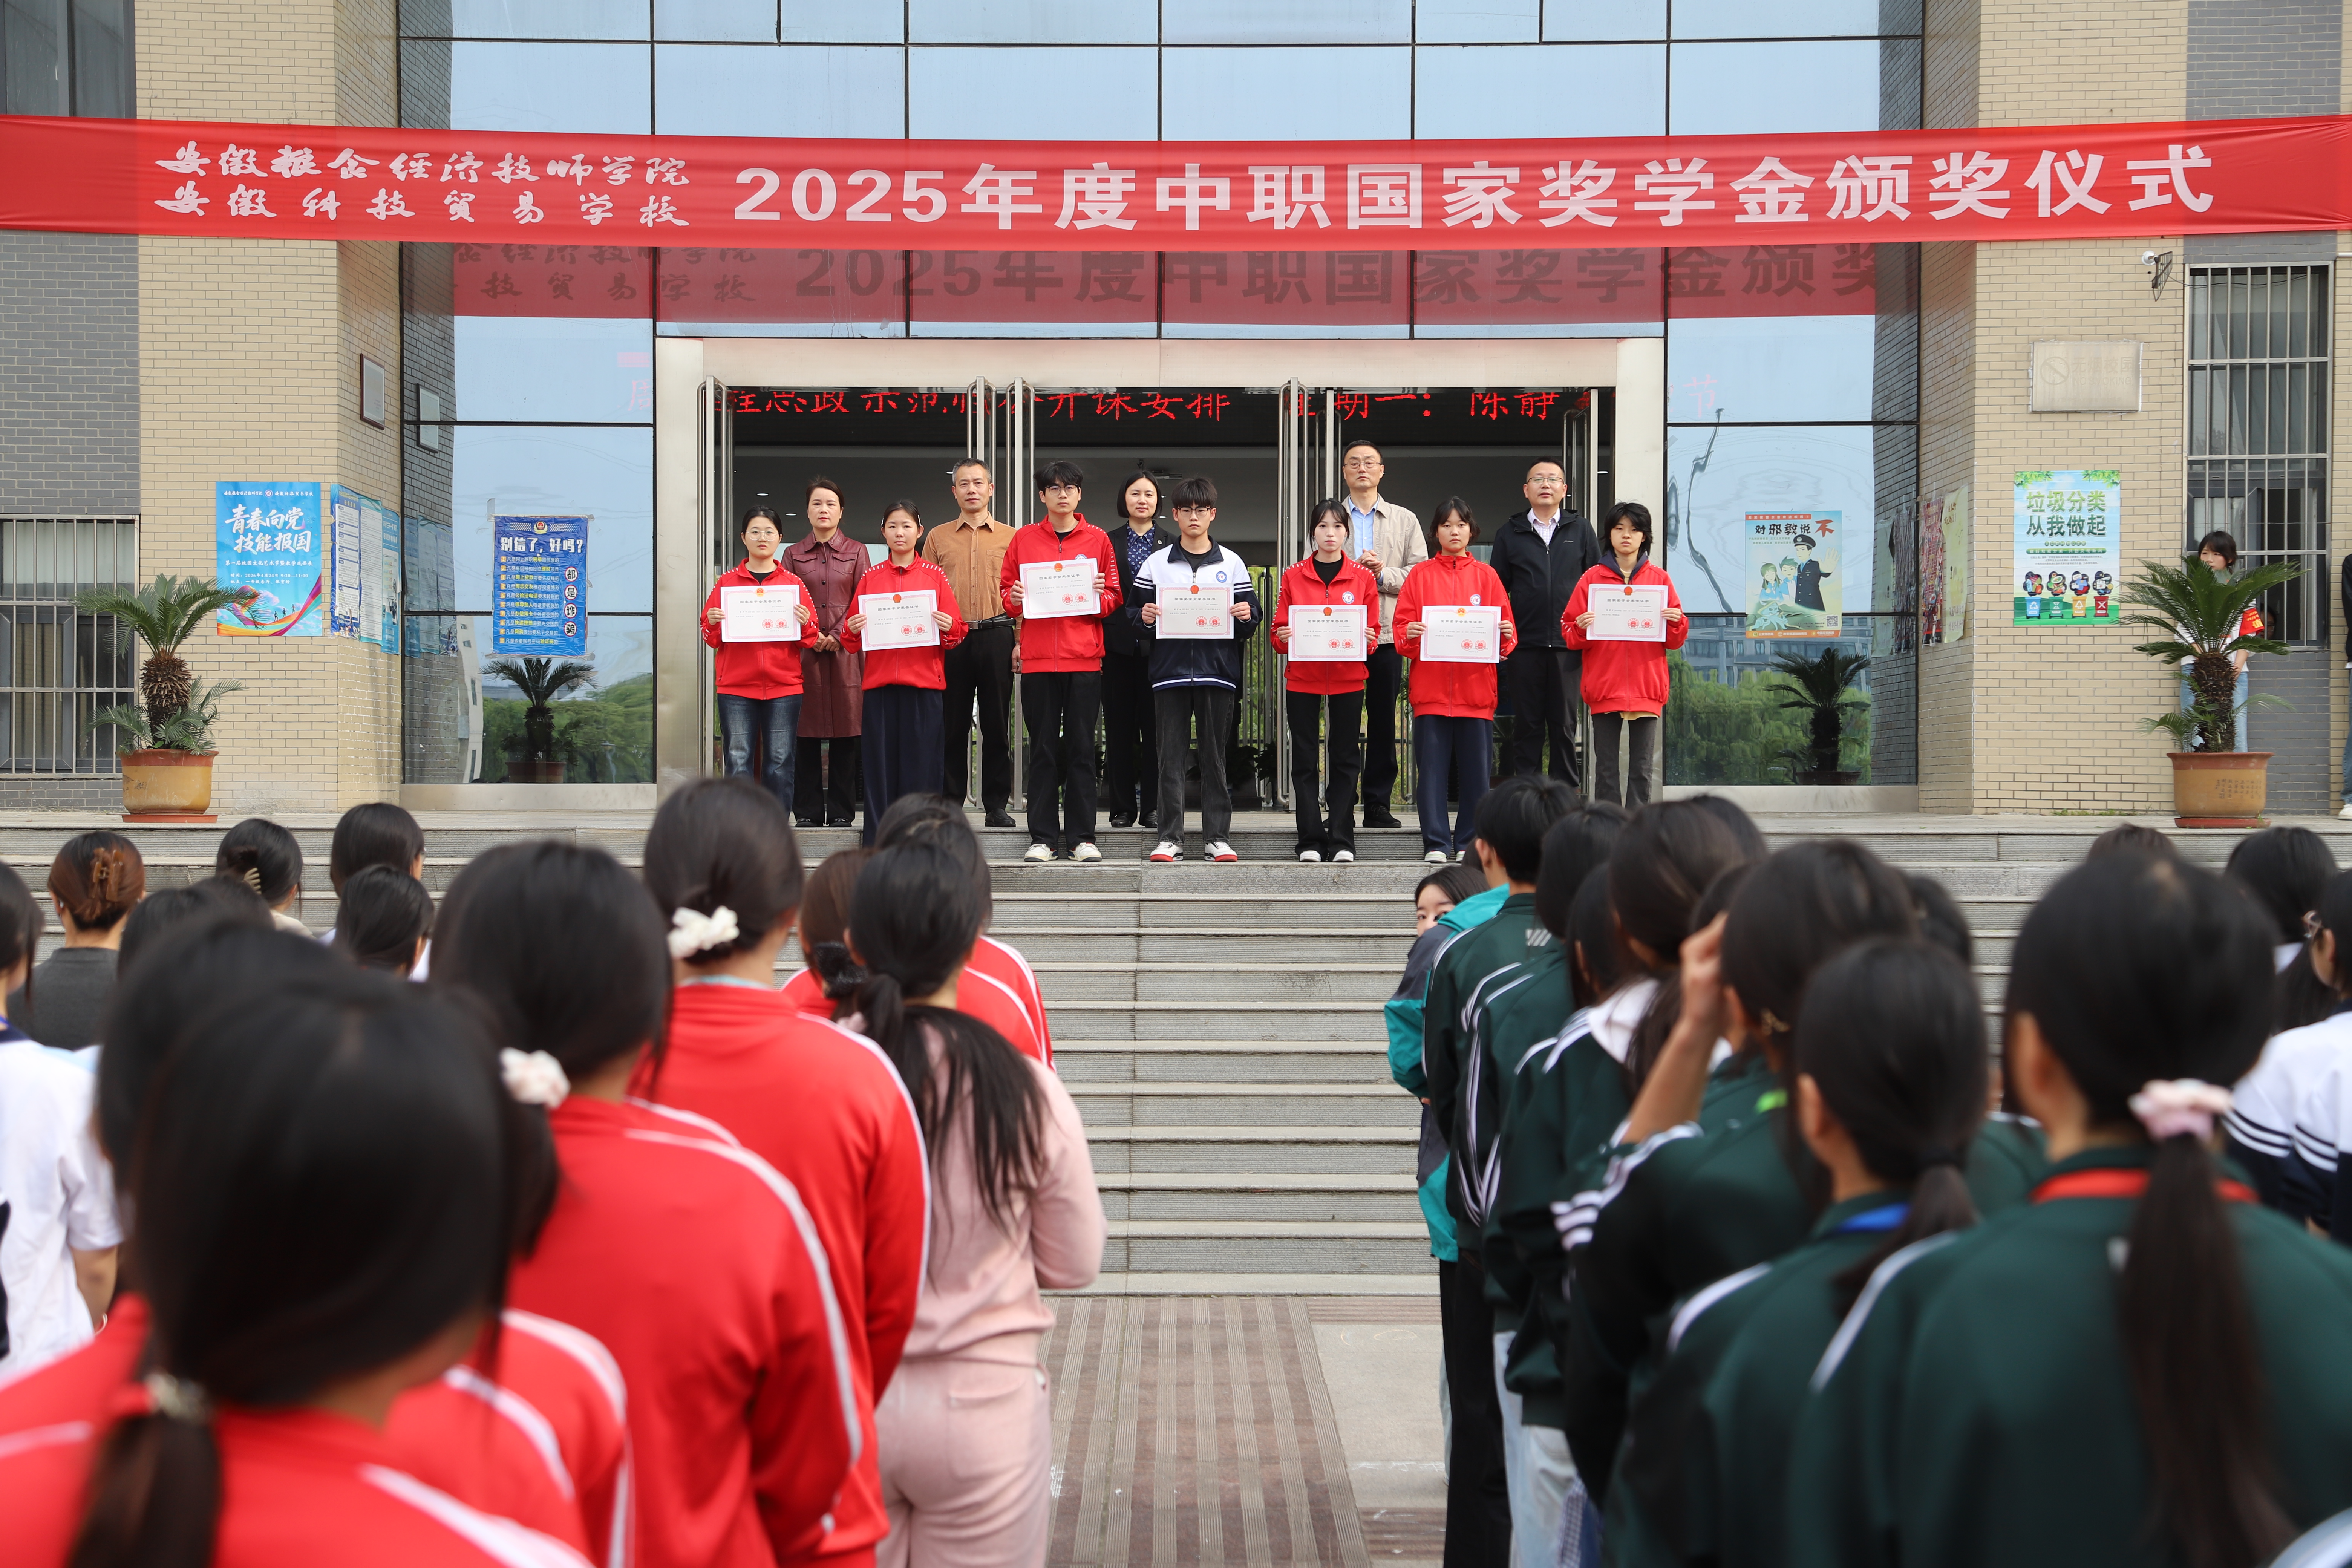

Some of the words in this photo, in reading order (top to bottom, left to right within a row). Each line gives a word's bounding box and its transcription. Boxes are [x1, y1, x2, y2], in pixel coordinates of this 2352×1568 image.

[735, 145, 2214, 231] 2025年度中职国家奖学金颁奖仪式
[2072, 357, 2134, 373] 无烟校园
[2026, 490, 2106, 513] 垃圾分类
[225, 504, 306, 534] 青春向党
[1755, 519, 1835, 538] 对邪教说不
[2026, 514, 2107, 537] 从我做起
[234, 530, 312, 555] 技能报国
